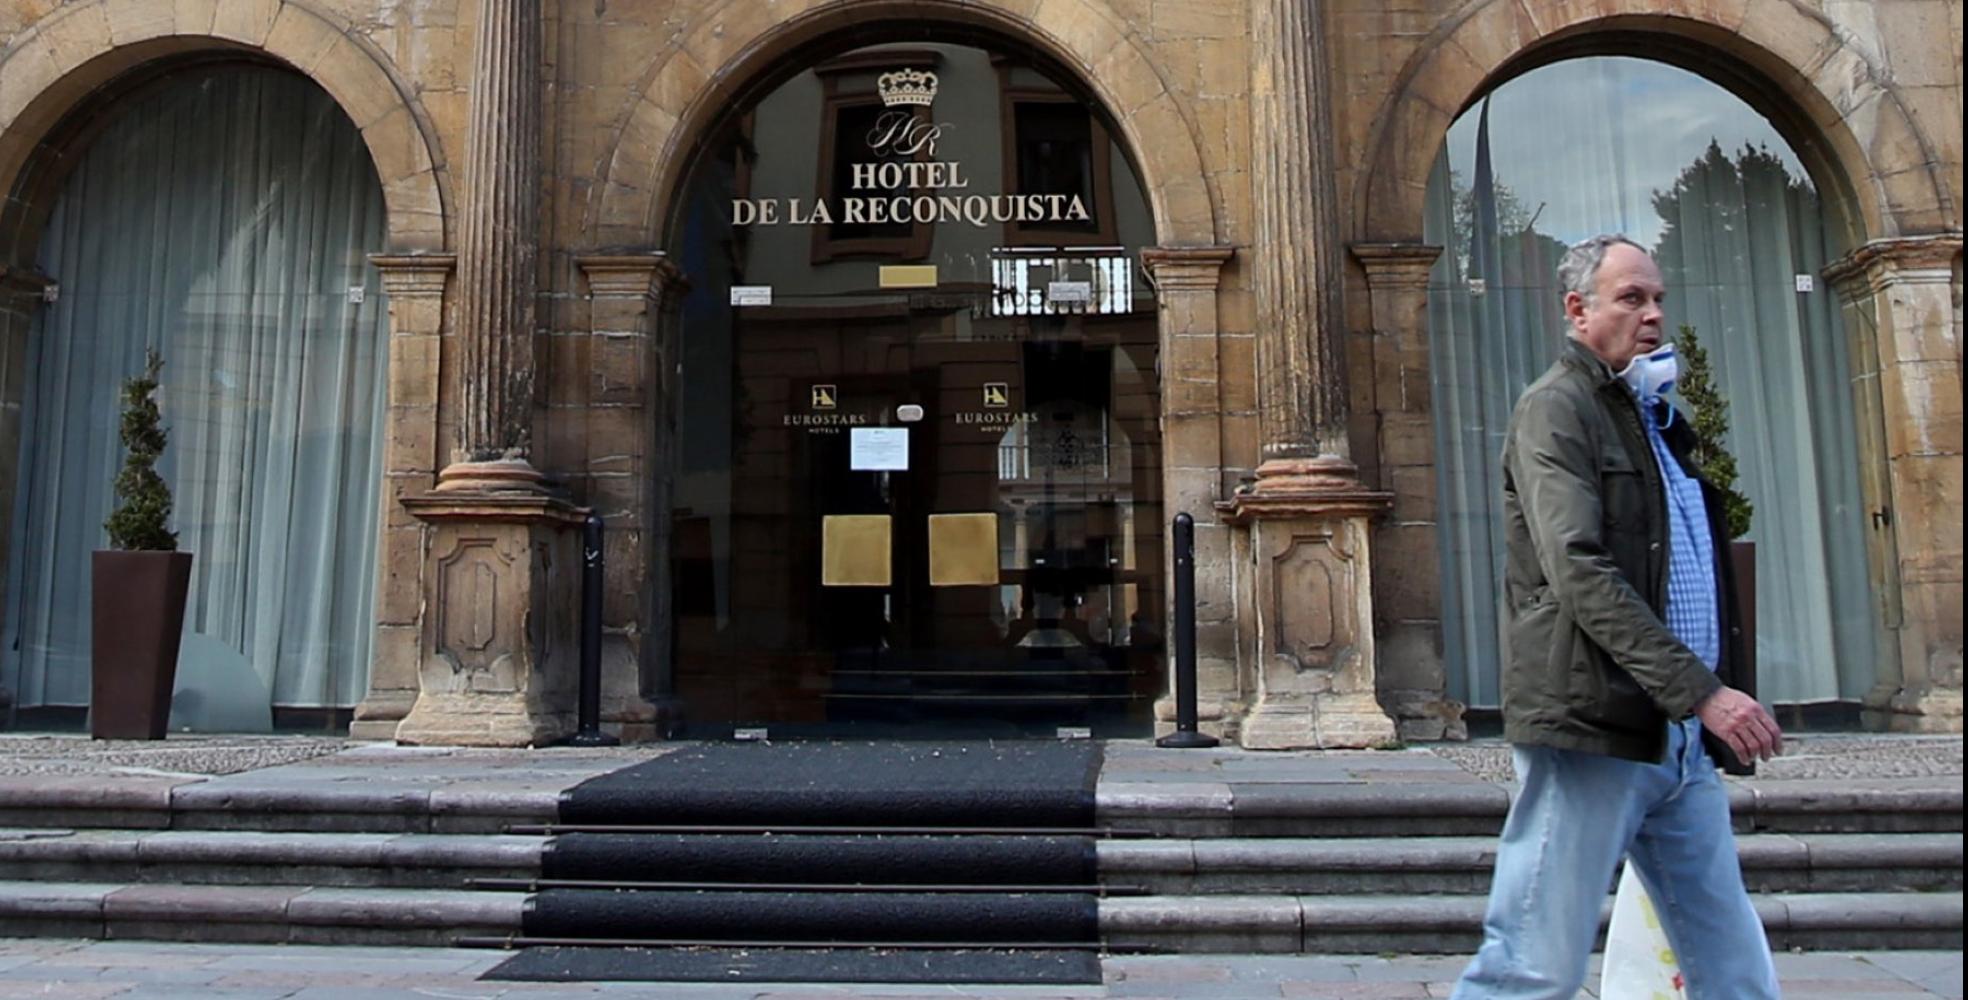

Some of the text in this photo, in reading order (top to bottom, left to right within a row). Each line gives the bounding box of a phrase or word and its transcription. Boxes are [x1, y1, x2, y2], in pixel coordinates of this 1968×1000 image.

[851, 162, 968, 190] HOTEL
[732, 194, 1090, 227] DE LA RECONQUISTA
[783, 414, 866, 425] EUROSTARS
[955, 412, 1039, 424] EUROSTARS
